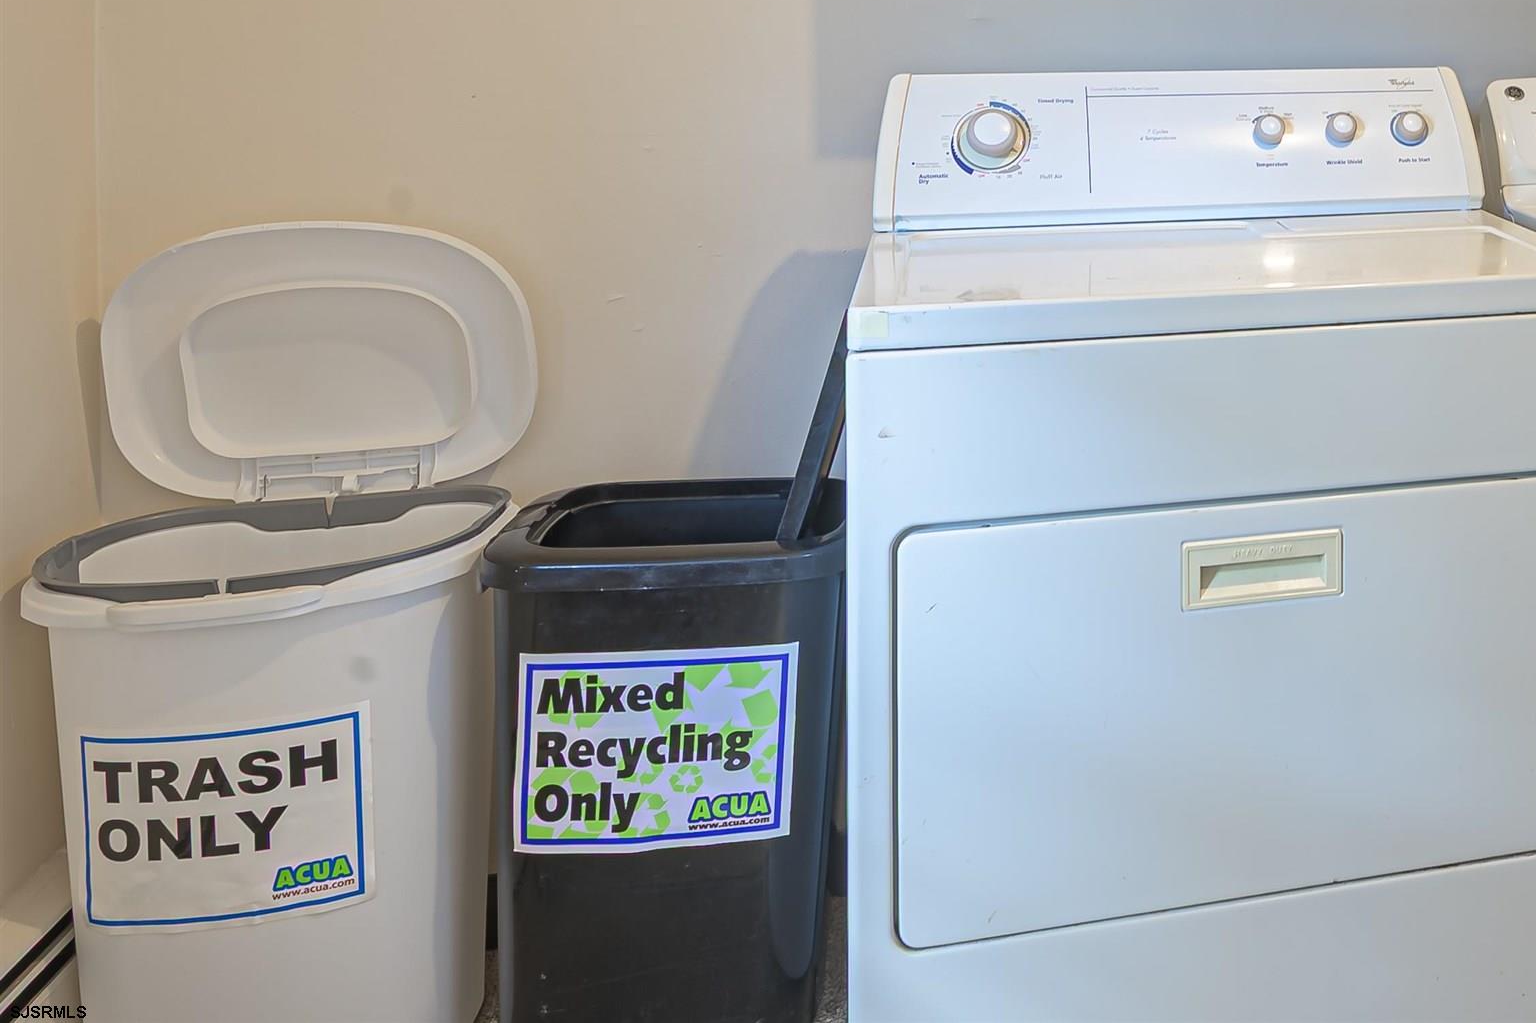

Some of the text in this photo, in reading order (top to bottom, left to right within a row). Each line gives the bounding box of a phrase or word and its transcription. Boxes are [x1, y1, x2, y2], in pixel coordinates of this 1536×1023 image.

[536, 672, 686, 715] Mixed
[93, 738, 339, 804] TRASH
[535, 723, 754, 779] Recycling
[534, 781, 641, 834] Only
[688, 790, 772, 825] ACUA
[688, 816, 771, 831] www.acua.com
[98, 804, 289, 863] ONLY
[271, 876, 356, 901] www.acua.com
[272, 854, 354, 892] ACUA
